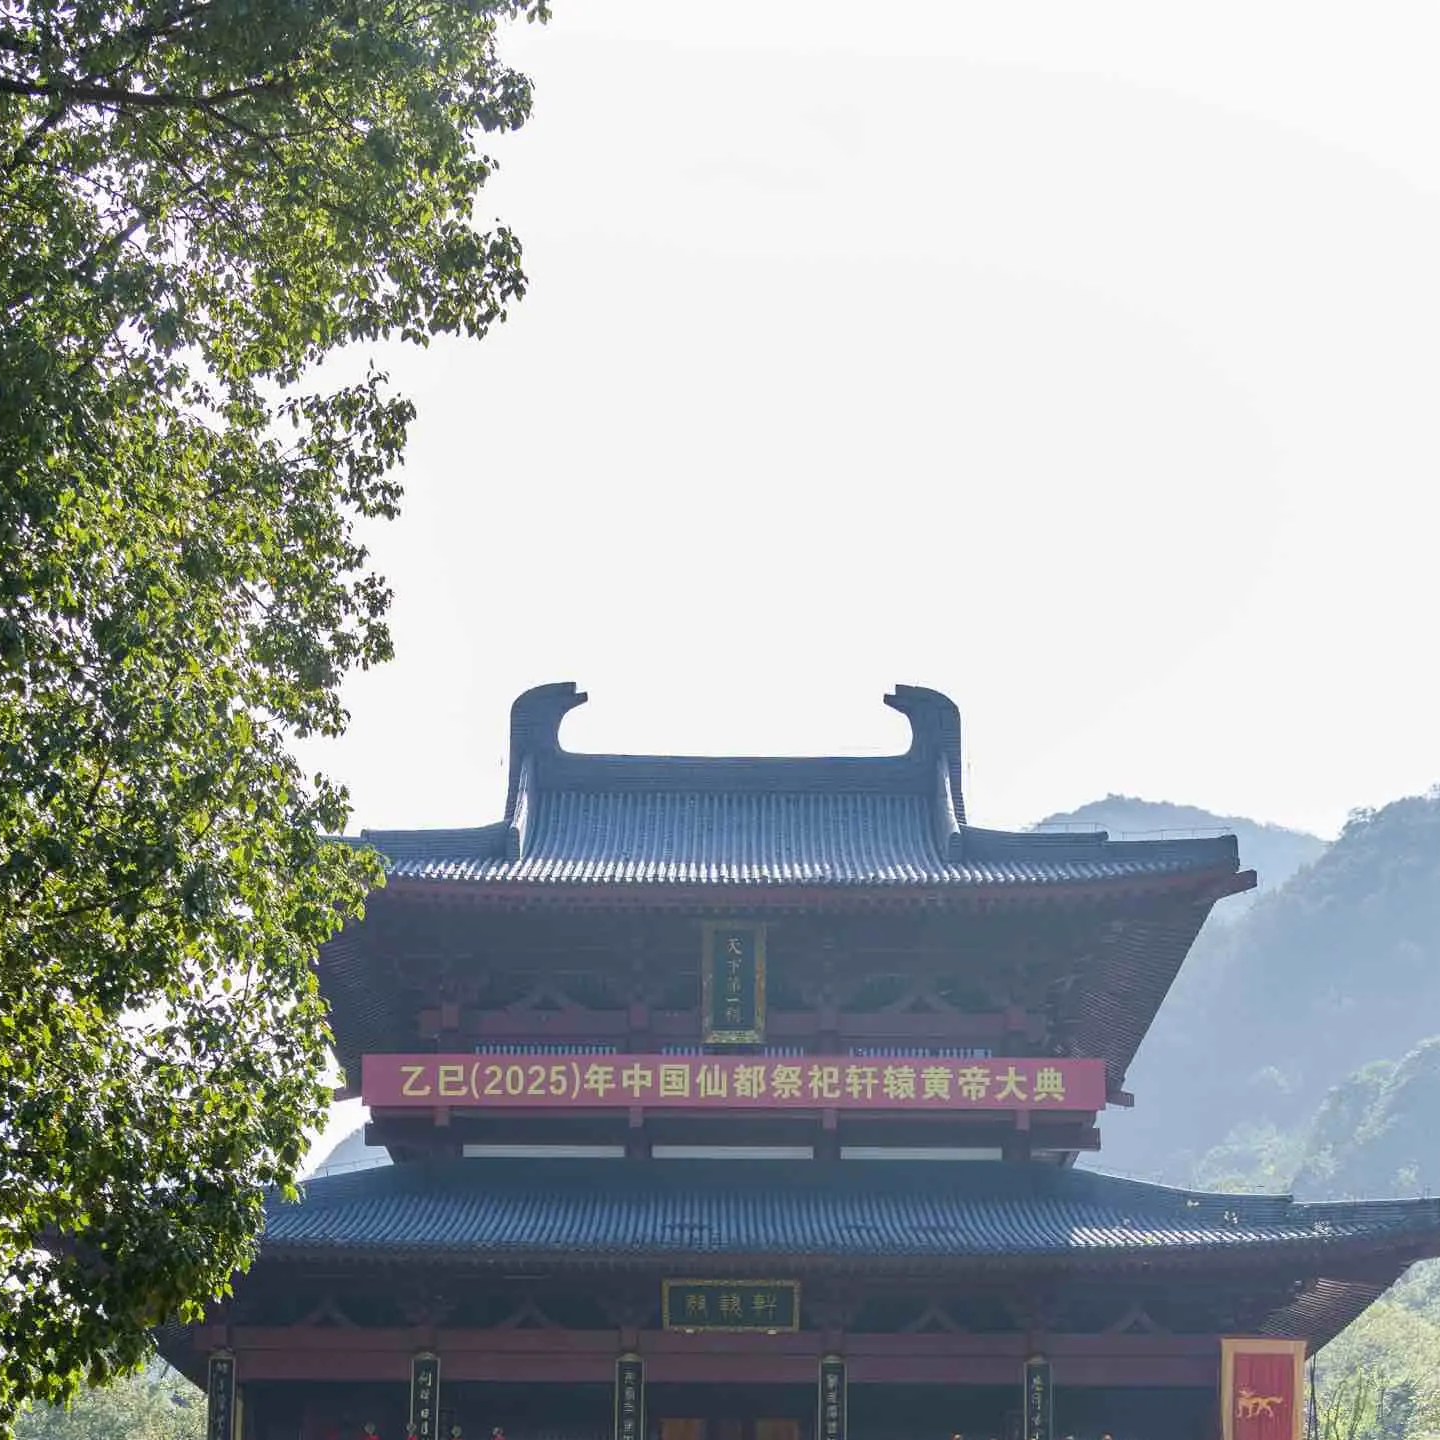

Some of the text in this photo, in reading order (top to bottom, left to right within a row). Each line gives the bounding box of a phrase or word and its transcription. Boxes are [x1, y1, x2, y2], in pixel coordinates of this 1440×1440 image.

[400, 1063, 1065, 1102] 乙巳(2025)年中国仙都祭祀轩辕黄帝大典
